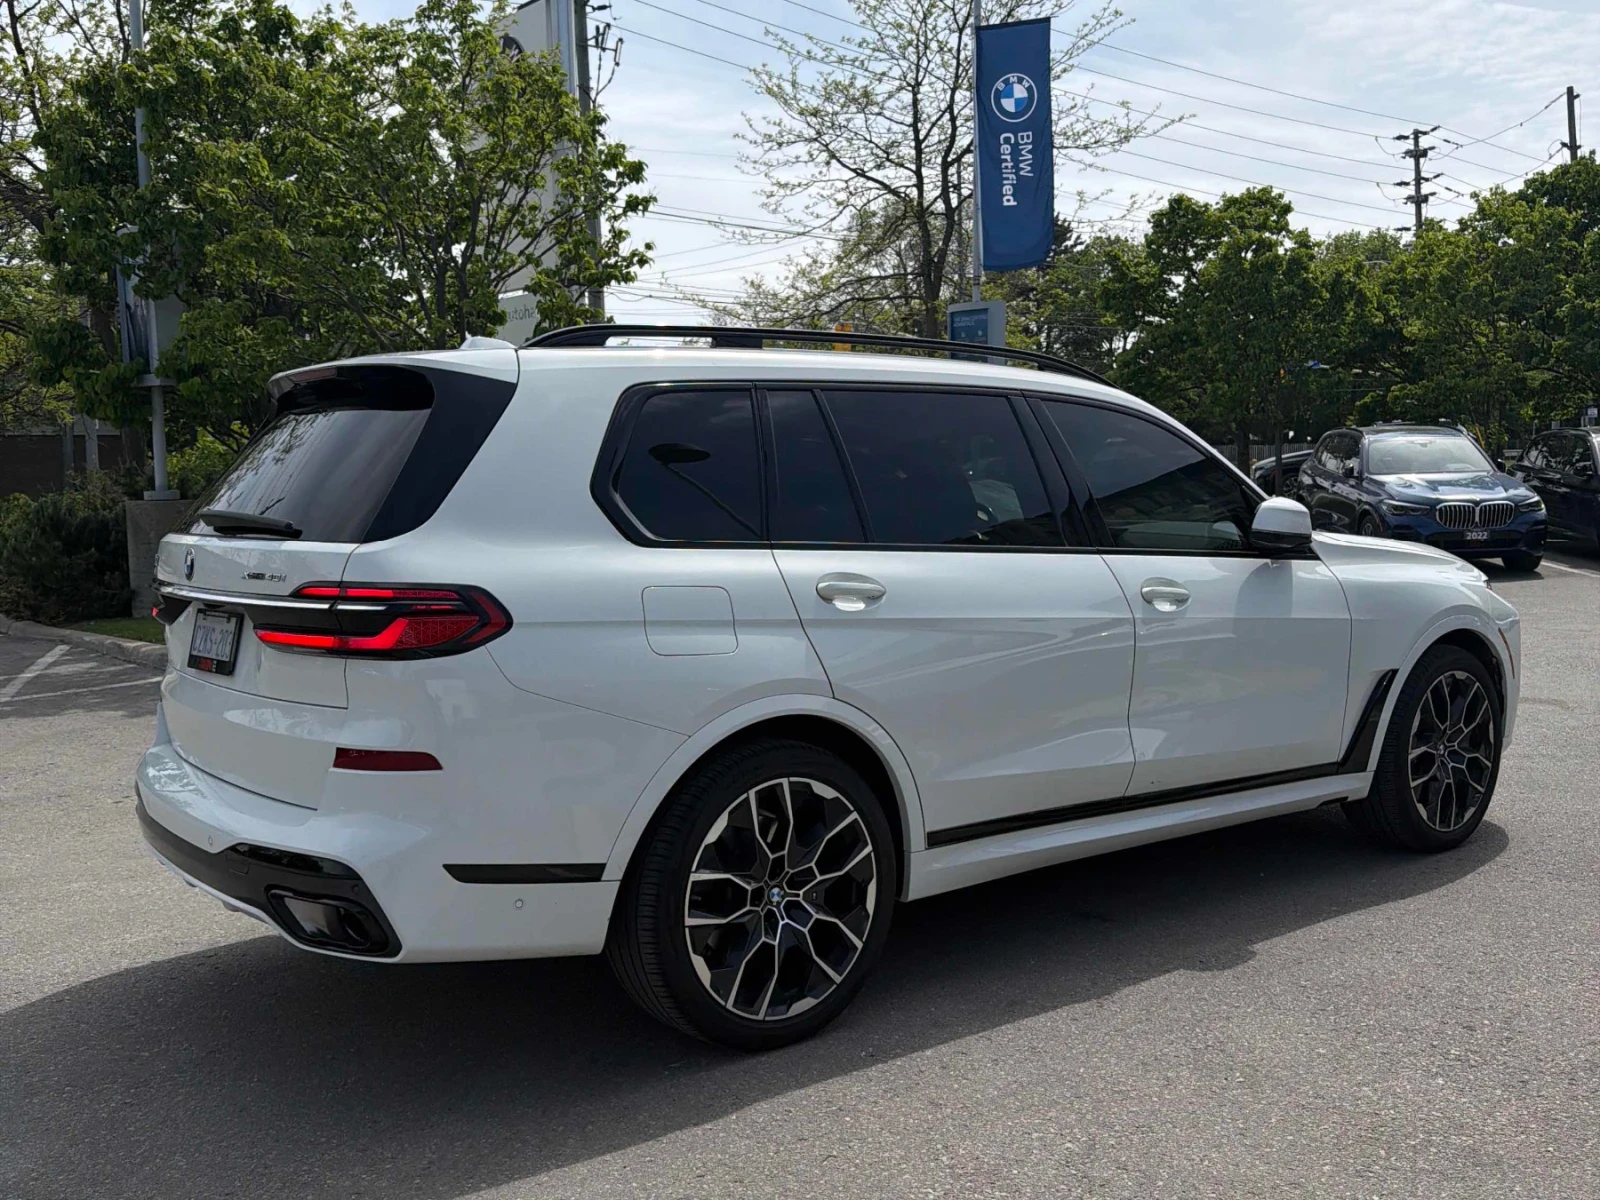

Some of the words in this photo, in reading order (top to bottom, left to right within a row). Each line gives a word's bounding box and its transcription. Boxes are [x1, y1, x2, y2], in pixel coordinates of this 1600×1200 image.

[997, 76, 1030, 91] BMW
[1018, 131, 1034, 176] BMW
[1000, 133, 1017, 206] Certified
[1466, 532, 1488, 540] 2022
